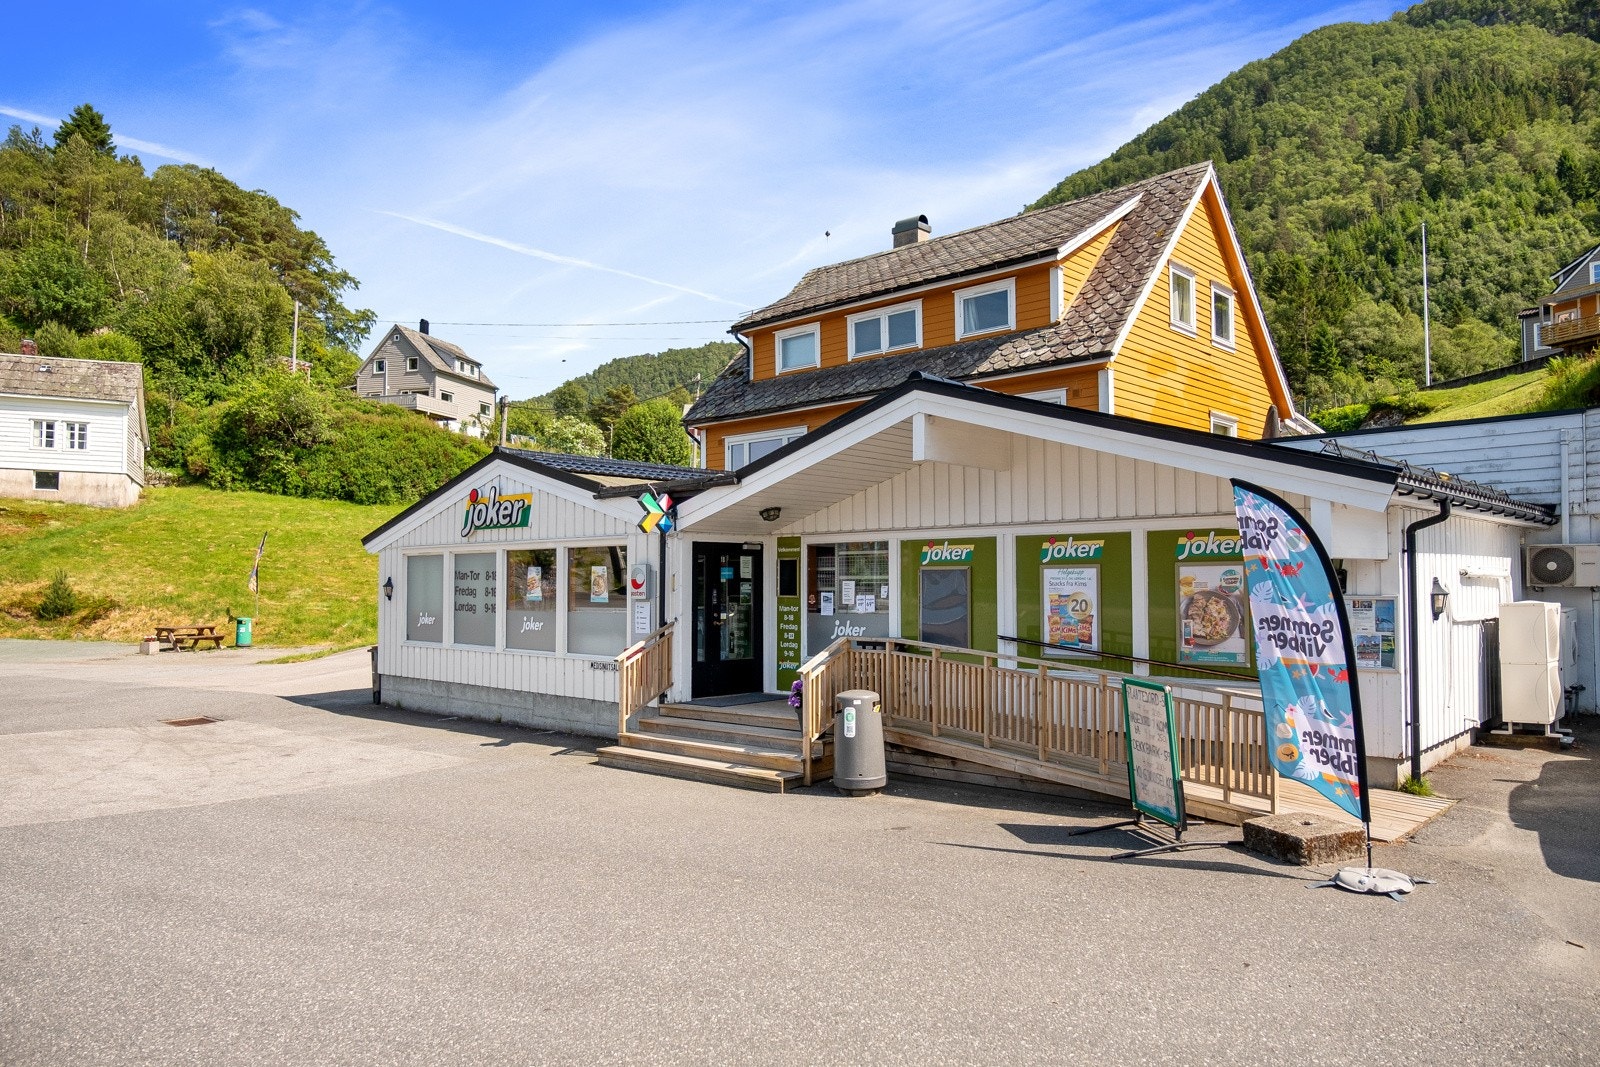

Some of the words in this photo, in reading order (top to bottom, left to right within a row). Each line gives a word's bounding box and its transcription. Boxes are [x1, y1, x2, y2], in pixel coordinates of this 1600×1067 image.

[461, 486, 525, 537] joker
[922, 541, 971, 565] joker
[1042, 536, 1100, 563] joker
[454, 586, 476, 598] Fredag
[1070, 599, 1088, 612] 20
[418, 612, 436, 627] joker
[521, 616, 544, 633] joker
[830, 620, 866, 639] joker
[590, 662, 620, 672] MEDISINUTSAL
